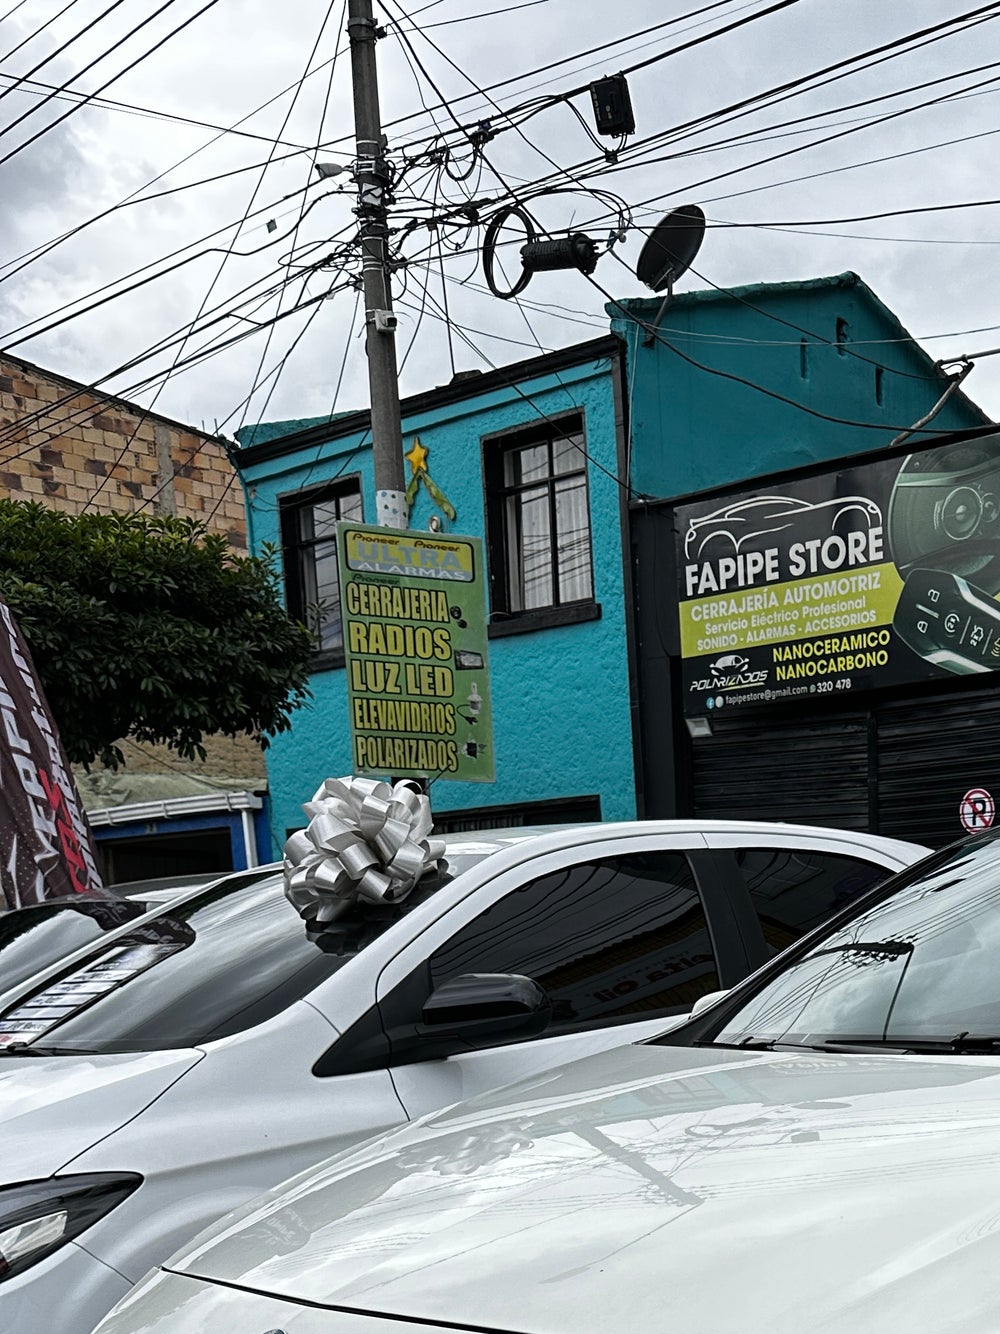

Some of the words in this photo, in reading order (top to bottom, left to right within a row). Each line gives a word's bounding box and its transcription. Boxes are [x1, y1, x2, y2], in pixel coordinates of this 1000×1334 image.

[353, 533, 400, 546] Pioneer
[413, 540, 460, 552] Pioneer
[358, 542, 462, 569] ULTRA
[685, 547, 780, 596] FAPIPE
[788, 526, 884, 577] STORE
[357, 562, 466, 580] ALARMAS
[347, 582, 449, 623] CERRAJERIA
[691, 588, 780, 622] CERRAJERÍA
[783, 572, 881, 605] AUTOMOTRIZ
[705, 617, 748, 635] Servicio
[751, 609, 799, 627] Eléctrico
[802, 595, 867, 618] Profesional
[349, 621, 451, 661] RADIOS
[697, 633, 738, 651] SONIDO
[746, 624, 796, 643] ALARMAS
[804, 610, 877, 633] ACCESORIOS
[773, 629, 891, 662] NANOCERAMICO
[351, 660, 401, 694] LUZ
[406, 663, 454, 698] LED
[690, 670, 769, 692] POLARIZADOS
[776, 650, 889, 681] NANOCARBONO
[725, 685, 808, 705] fapipestore@gmail.com
[817, 681, 834, 693] 320
[836, 678, 852, 690] 478
[354, 698, 456, 735] ELEVAVIDRIOS
[355, 735, 458, 772] POLARIZADOS
